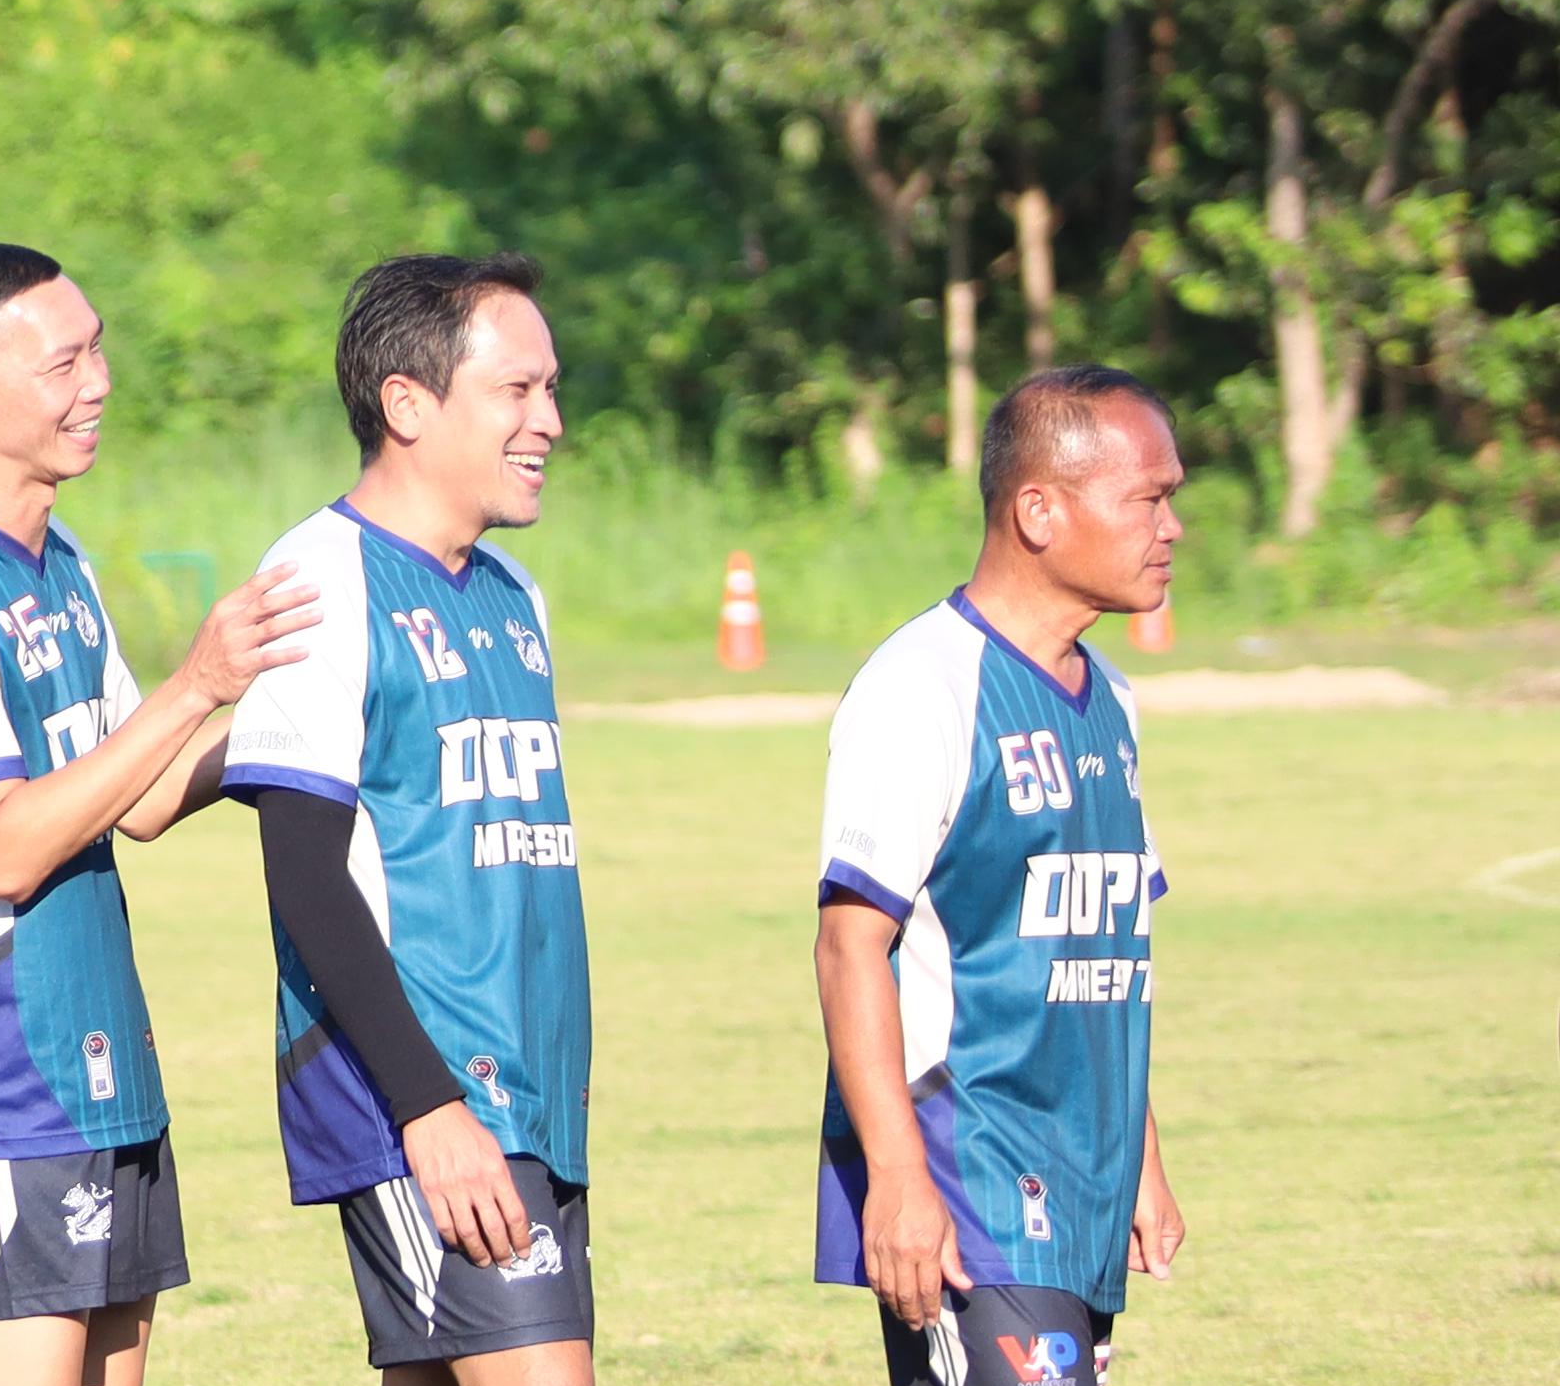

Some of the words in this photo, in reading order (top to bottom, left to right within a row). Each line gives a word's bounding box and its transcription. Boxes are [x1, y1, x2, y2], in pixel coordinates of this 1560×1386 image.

[390, 607, 468, 683] 12
[436, 718, 569, 808] DOP
[996, 728, 1073, 815] 50
[472, 820, 578, 868] MAESO
